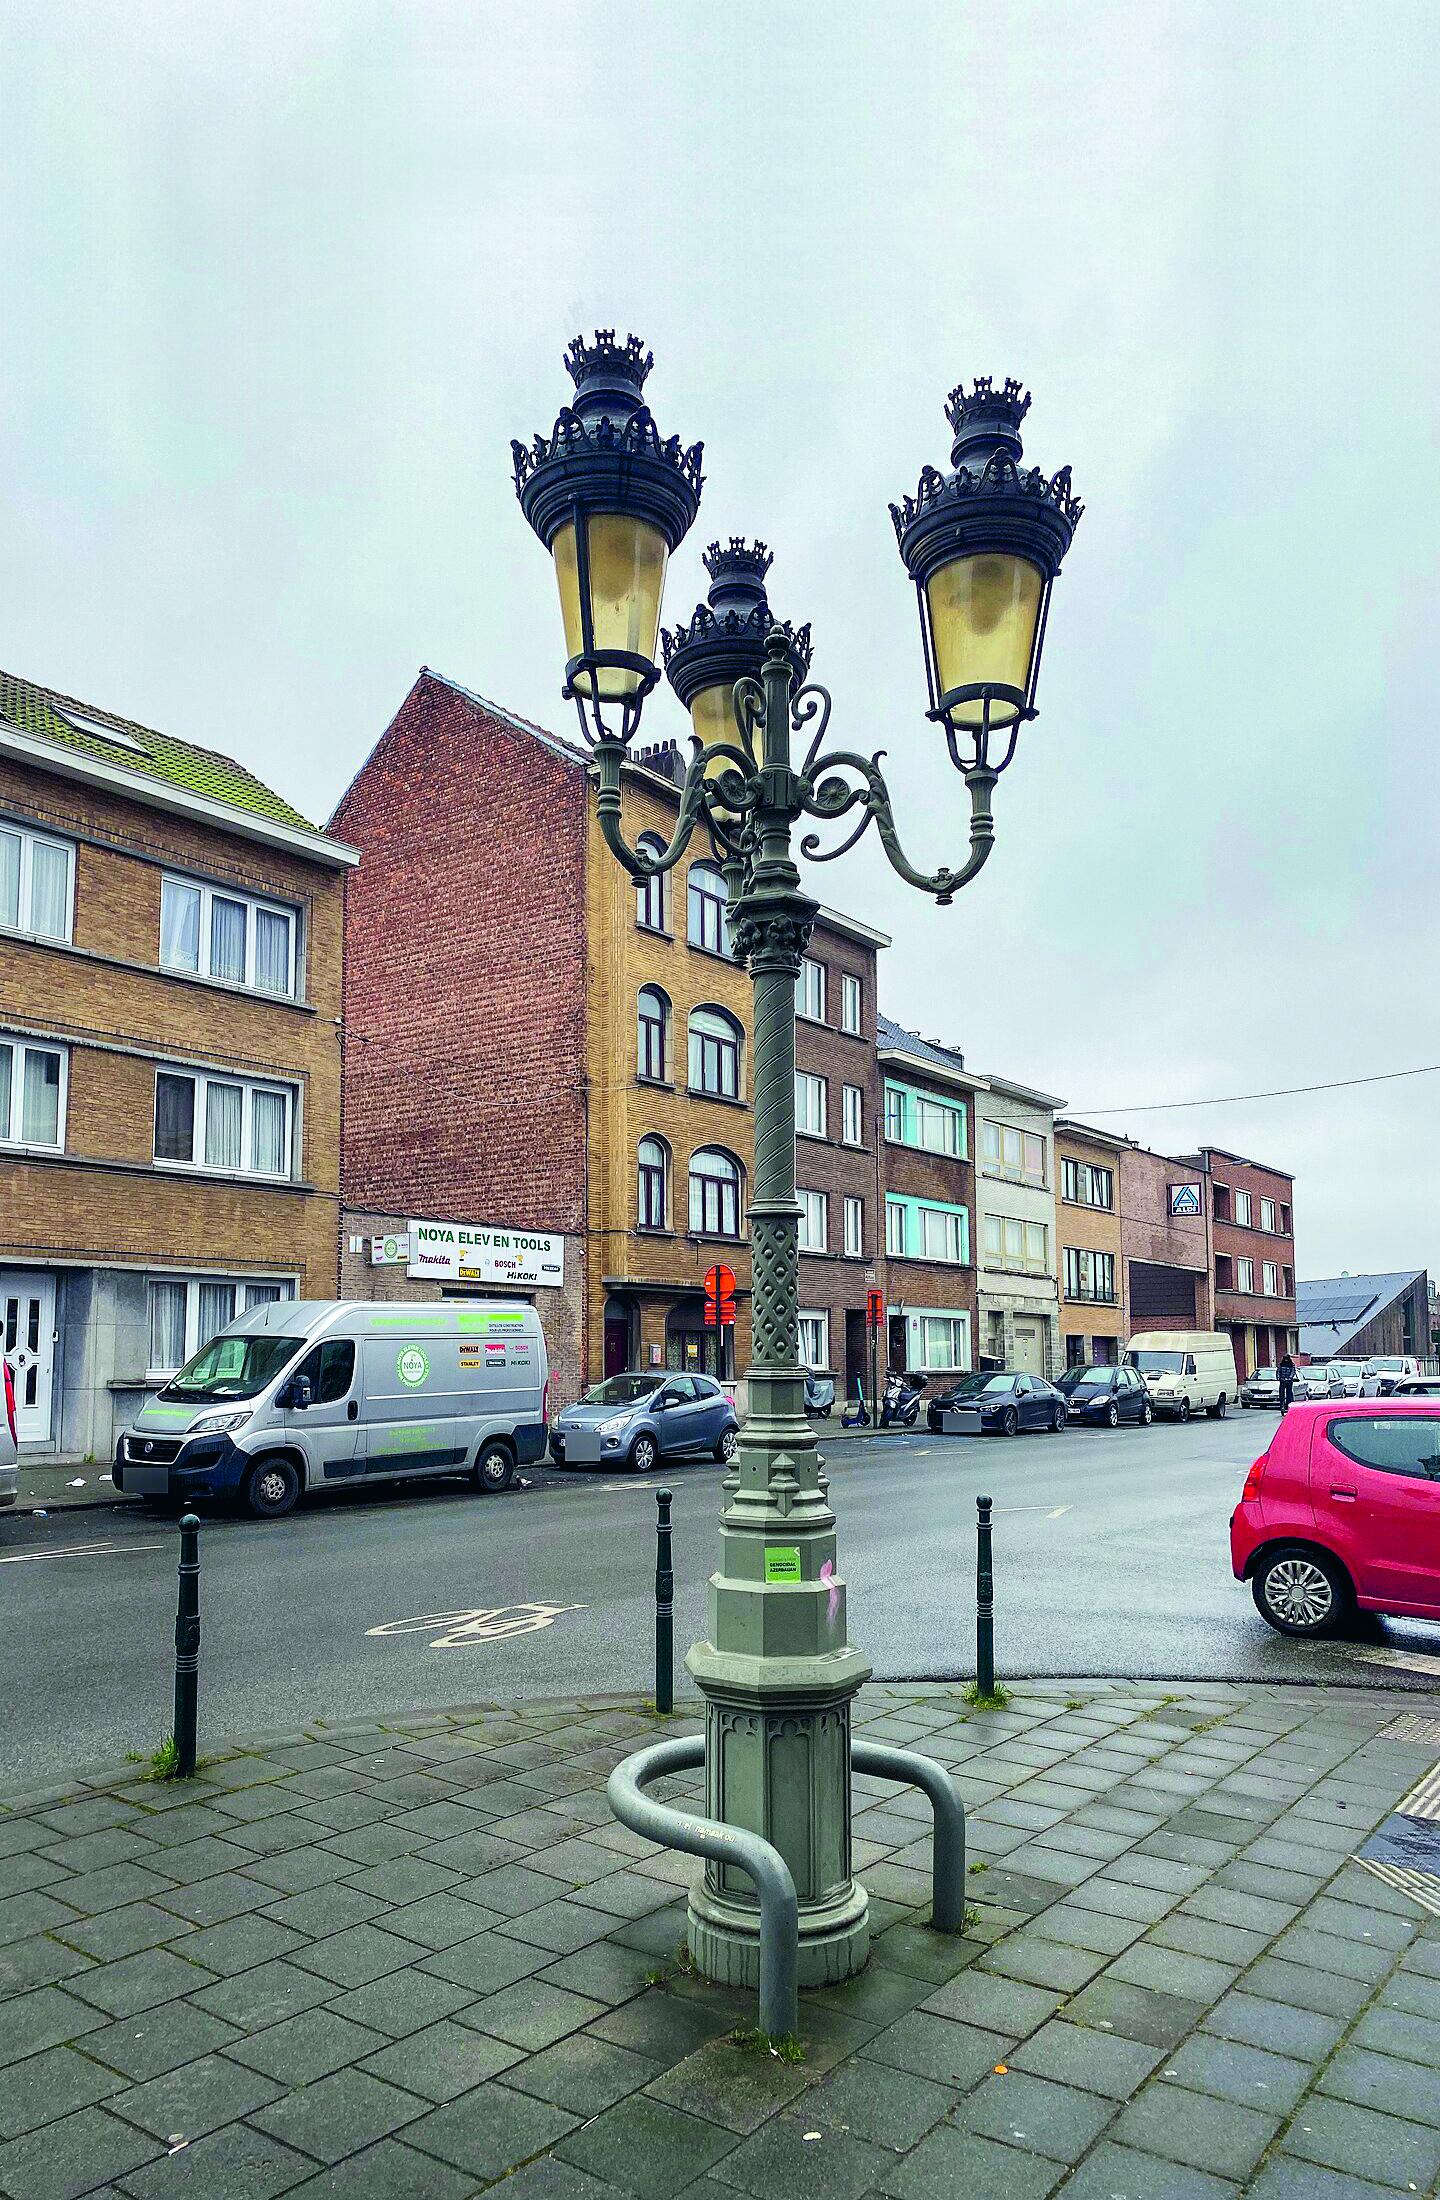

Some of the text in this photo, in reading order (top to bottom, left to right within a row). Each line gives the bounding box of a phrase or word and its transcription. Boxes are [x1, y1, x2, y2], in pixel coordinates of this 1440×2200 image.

[418, 1227, 455, 1243] NOYA
[512, 1236, 551, 1252] TOOLS
[494, 1260, 516, 1269] BOSCH
[403, 1361, 423, 1370] NOYA
